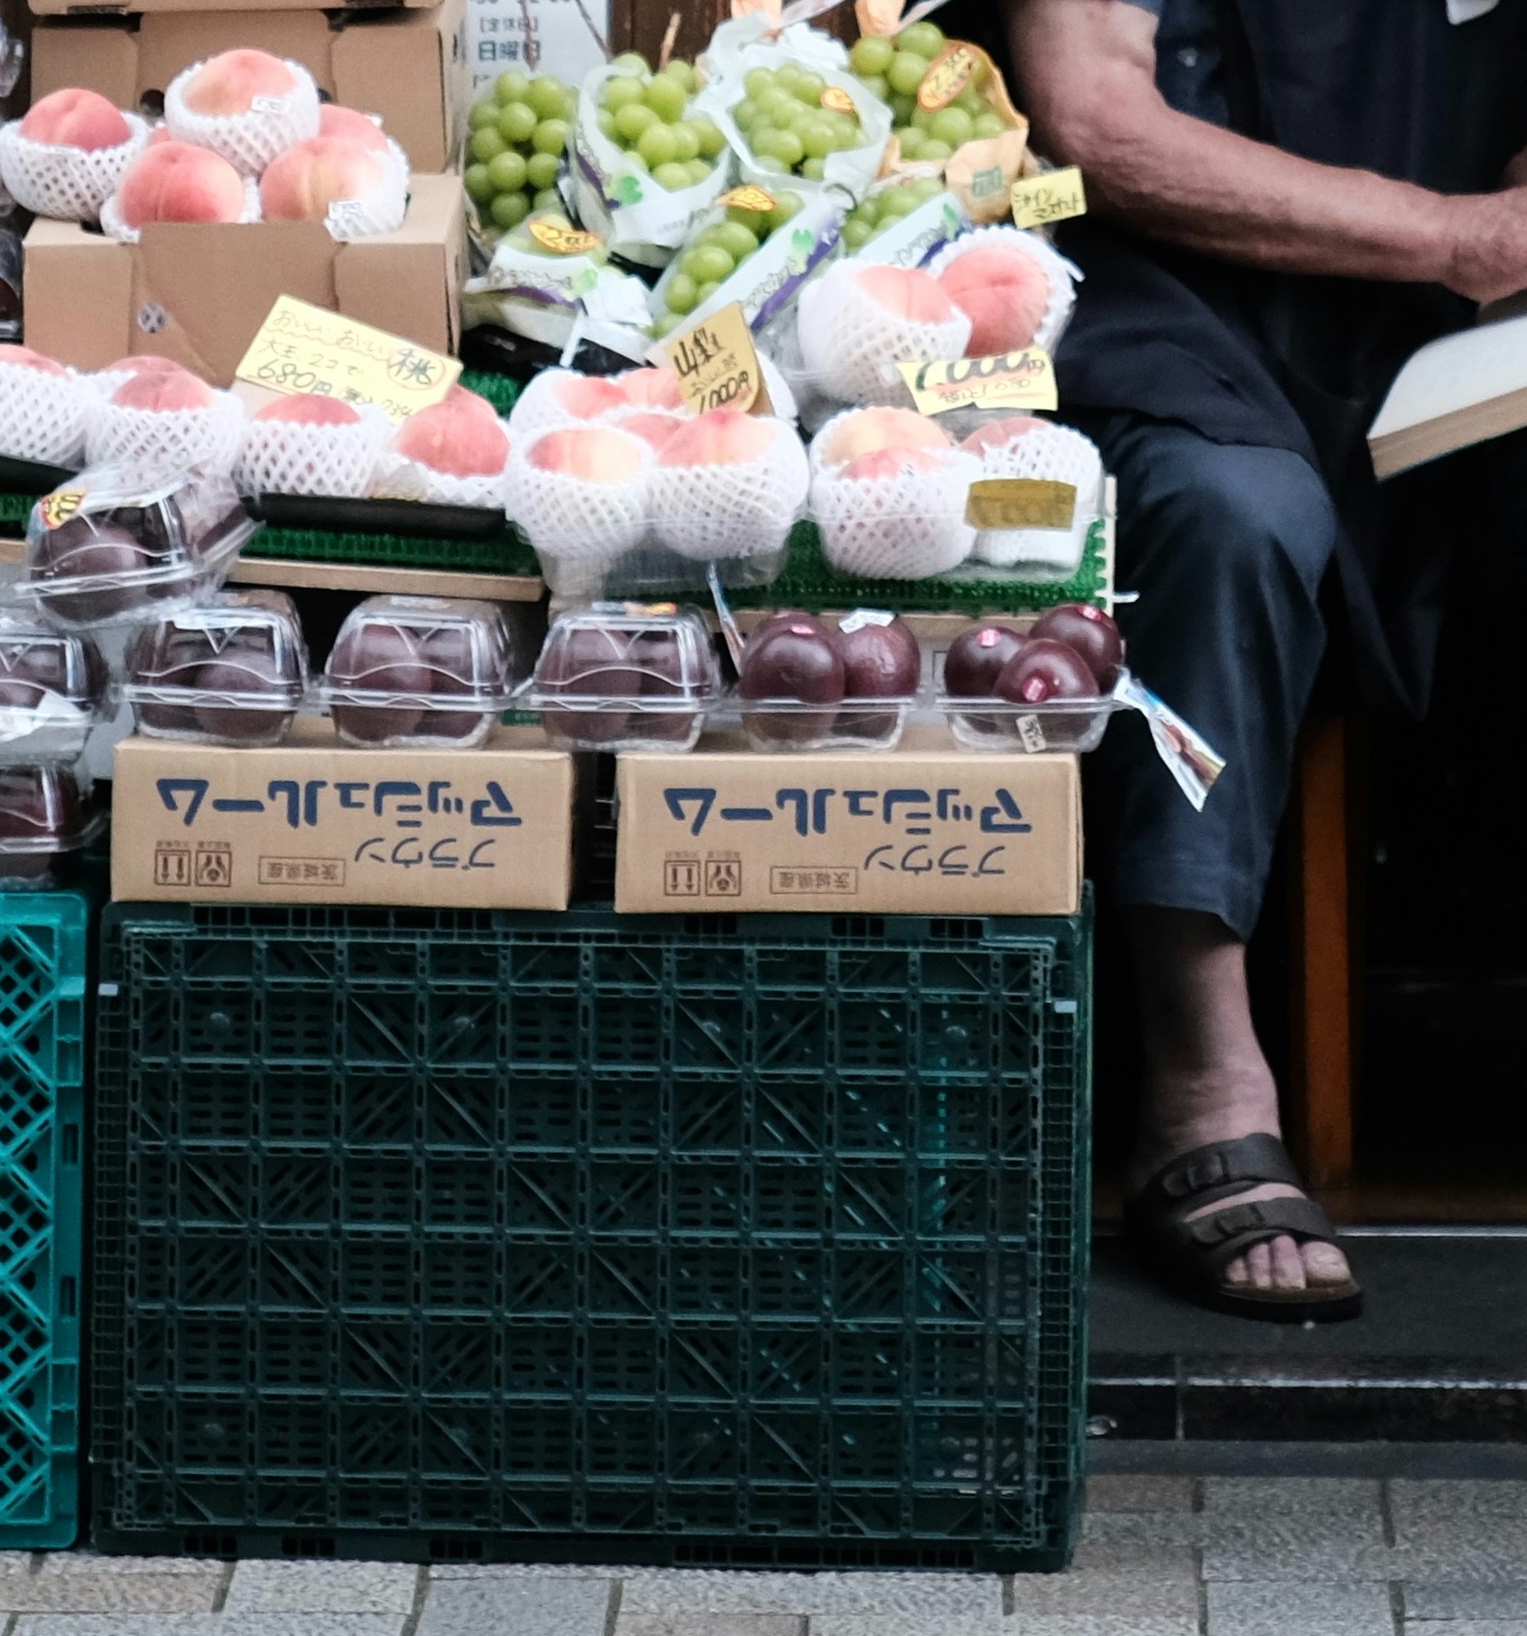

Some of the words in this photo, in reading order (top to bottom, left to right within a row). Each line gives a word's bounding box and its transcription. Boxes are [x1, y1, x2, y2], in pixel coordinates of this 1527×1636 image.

[387, 349, 435, 386] 桃
[155, 778, 523, 830] マッシュルーム
[662, 787, 1033, 838] マッシュルーム
[354, 837, 497, 870] ブラウン
[863, 844, 1006, 878] ブラウン
